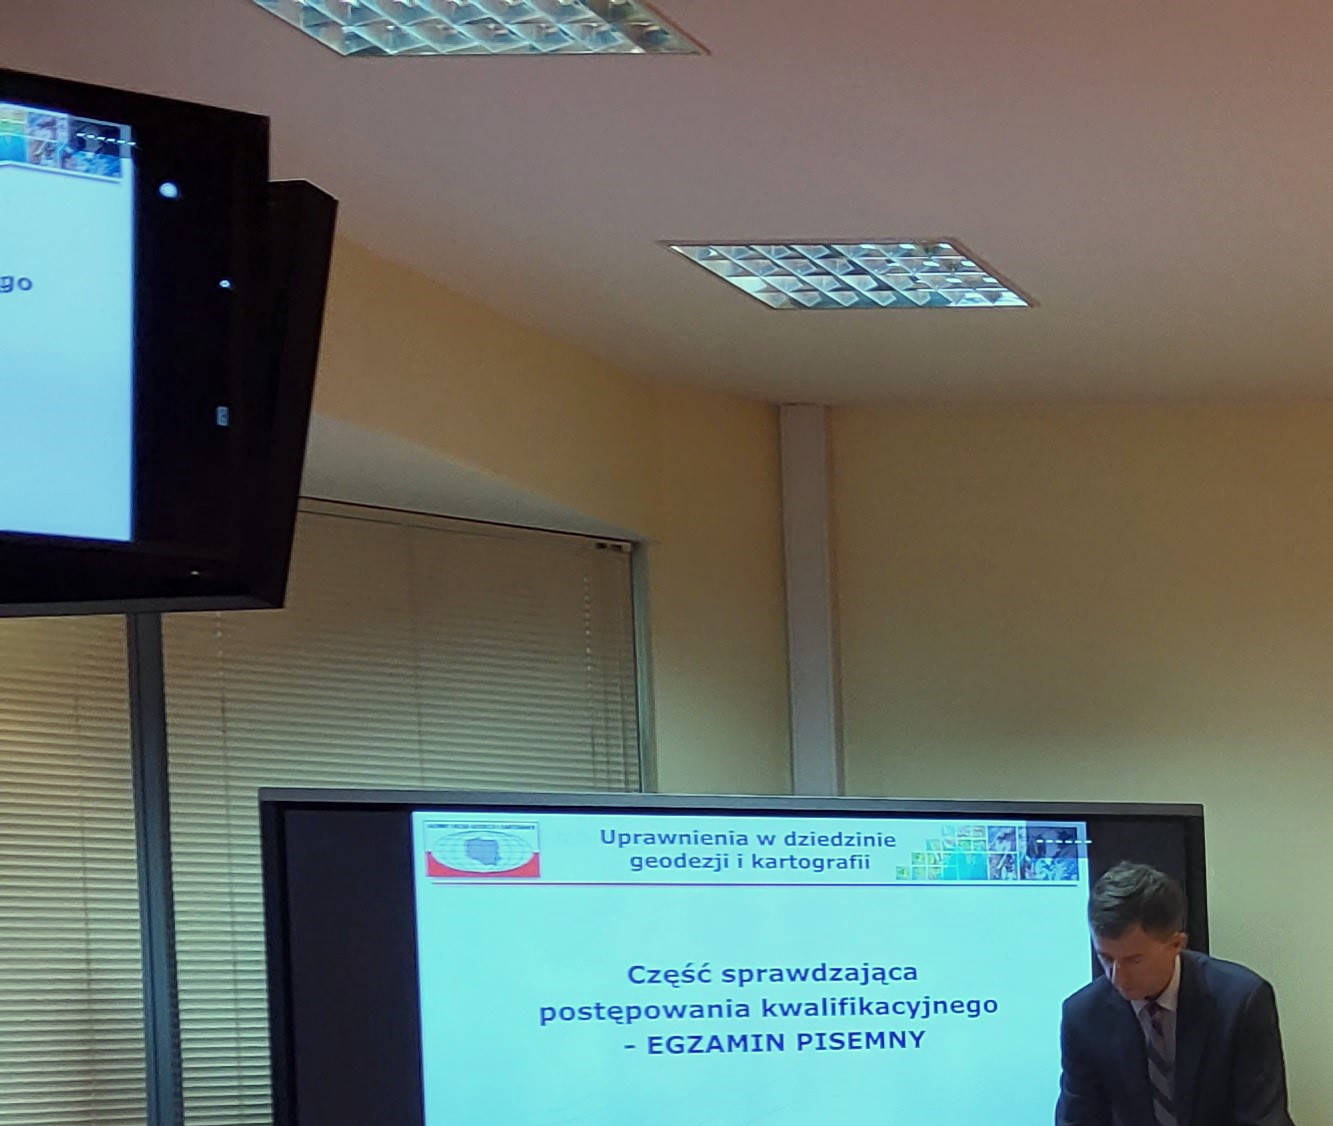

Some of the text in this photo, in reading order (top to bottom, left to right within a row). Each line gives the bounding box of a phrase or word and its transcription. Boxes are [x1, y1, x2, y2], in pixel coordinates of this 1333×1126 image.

[600, 829, 896, 848] Uprawnienia w dziedzinie
[630, 853, 870, 872] geodezji i kartografii
[627, 963, 918, 988] Część sprawdzająca
[539, 996, 998, 1026] postępowania kwalifikacyjnego
[647, 1033, 784, 1055] EGZAMIN
[797, 1031, 926, 1051] PISEMNY
